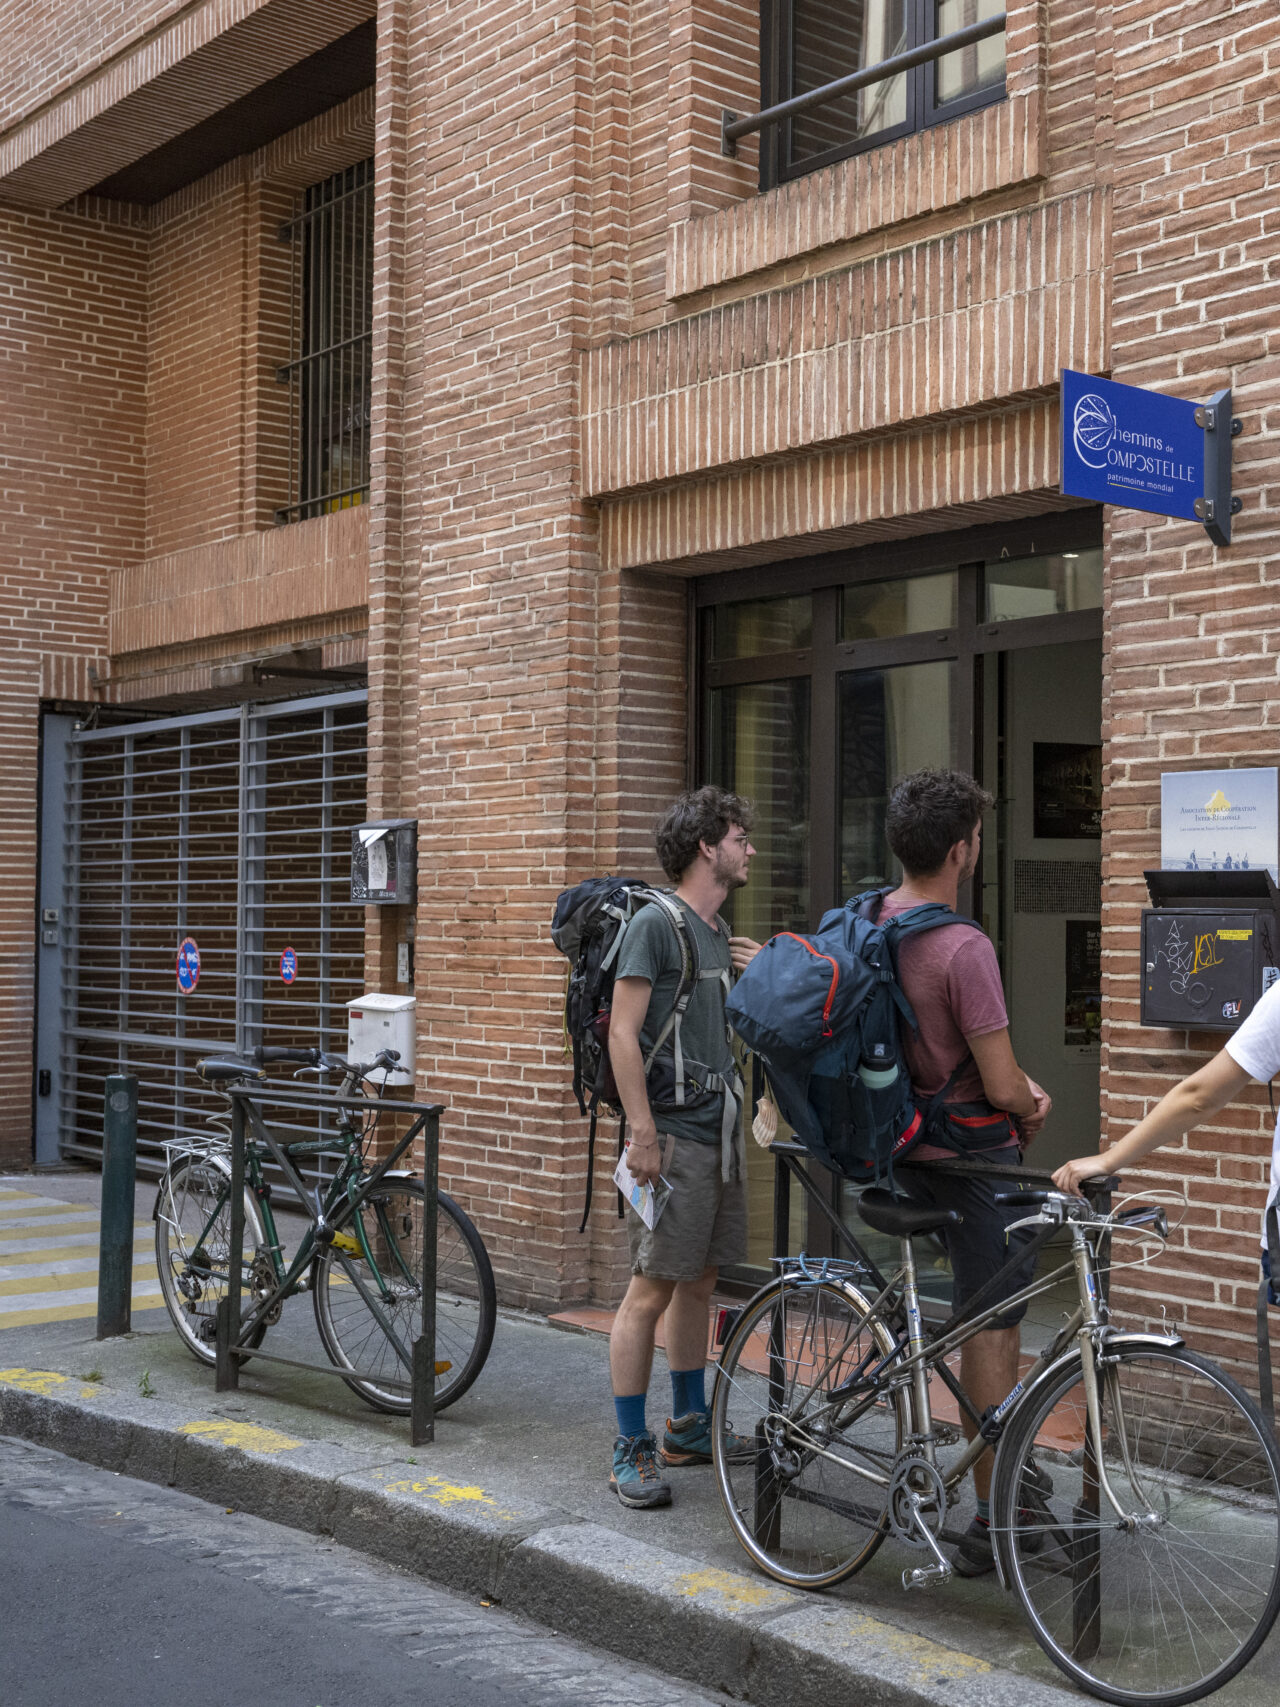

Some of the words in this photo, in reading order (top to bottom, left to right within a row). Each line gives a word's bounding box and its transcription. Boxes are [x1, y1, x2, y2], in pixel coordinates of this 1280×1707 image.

[1165, 445, 1174, 453] de
[1107, 472, 1145, 487] patrimoine
[1147, 480, 1174, 493] mondial
